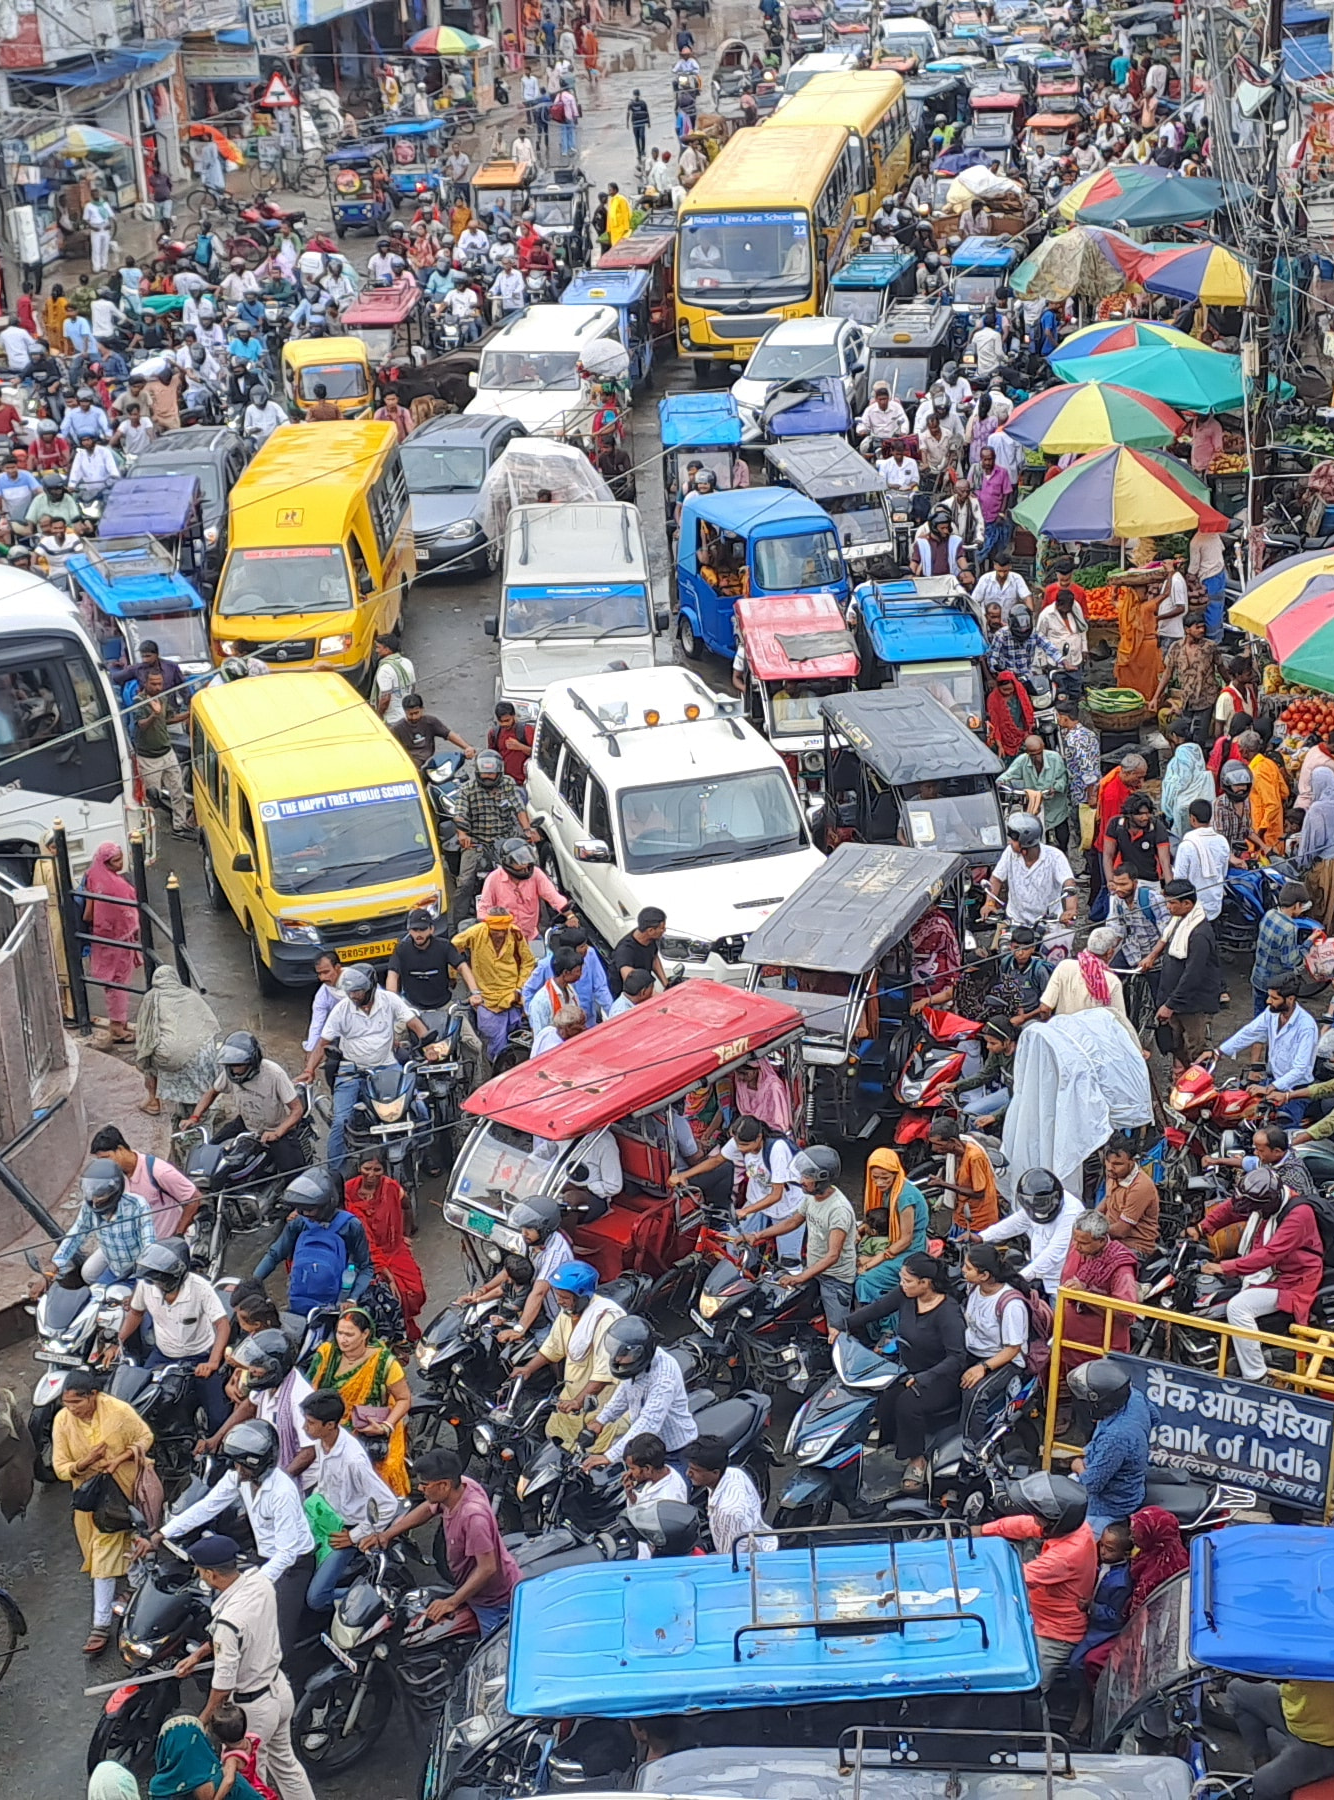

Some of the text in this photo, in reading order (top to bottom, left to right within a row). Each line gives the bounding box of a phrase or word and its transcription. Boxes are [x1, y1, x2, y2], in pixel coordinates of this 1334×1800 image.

[764, 212, 793, 222] School
[279, 783, 417, 815] THE HAPPY TREE PUBLIC SCHOOL
[1147, 1367, 1199, 1412] बैंक
[1259, 1396, 1331, 1447] इंडिया
[1149, 1423, 1321, 1483] ank of India
